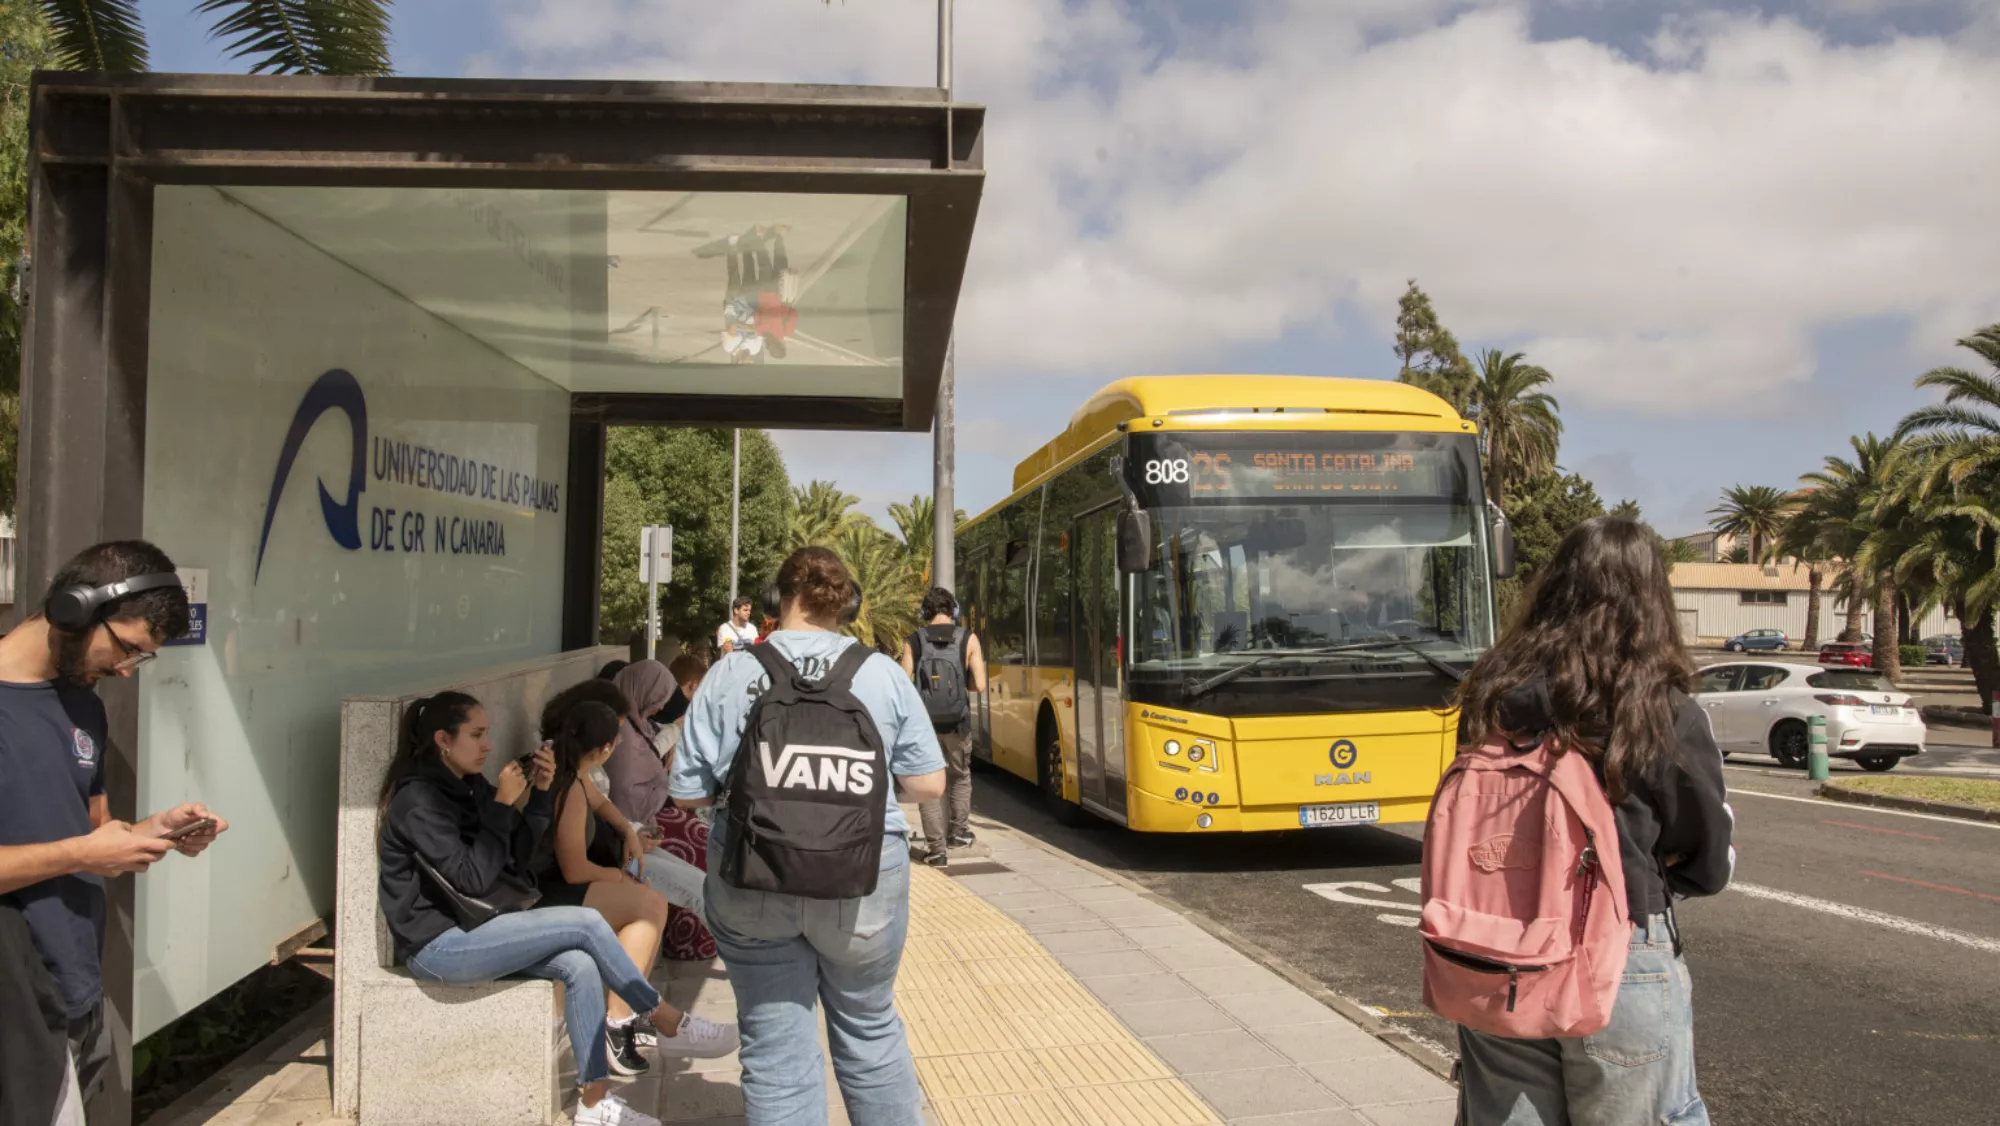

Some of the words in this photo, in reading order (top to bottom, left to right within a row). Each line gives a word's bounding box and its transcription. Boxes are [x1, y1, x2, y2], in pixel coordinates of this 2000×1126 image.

[374, 436, 478, 497] UNIVERSIDAD
[481, 463, 497, 499] DE
[500, 469, 520, 504] LAS
[523, 475, 559, 513] PALMAS
[1145, 458, 1189, 484] 808
[1322, 453, 1414, 471] CATALINA
[371, 507, 396, 551] DE
[401, 511, 447, 553] GRN
[450, 517, 506, 556] CANARIA
[759, 742, 876, 795] VANS
[1314, 771, 1371, 786] MAN
[1312, 806, 1345, 821] 1620
[1349, 804, 1376, 819] LLR
